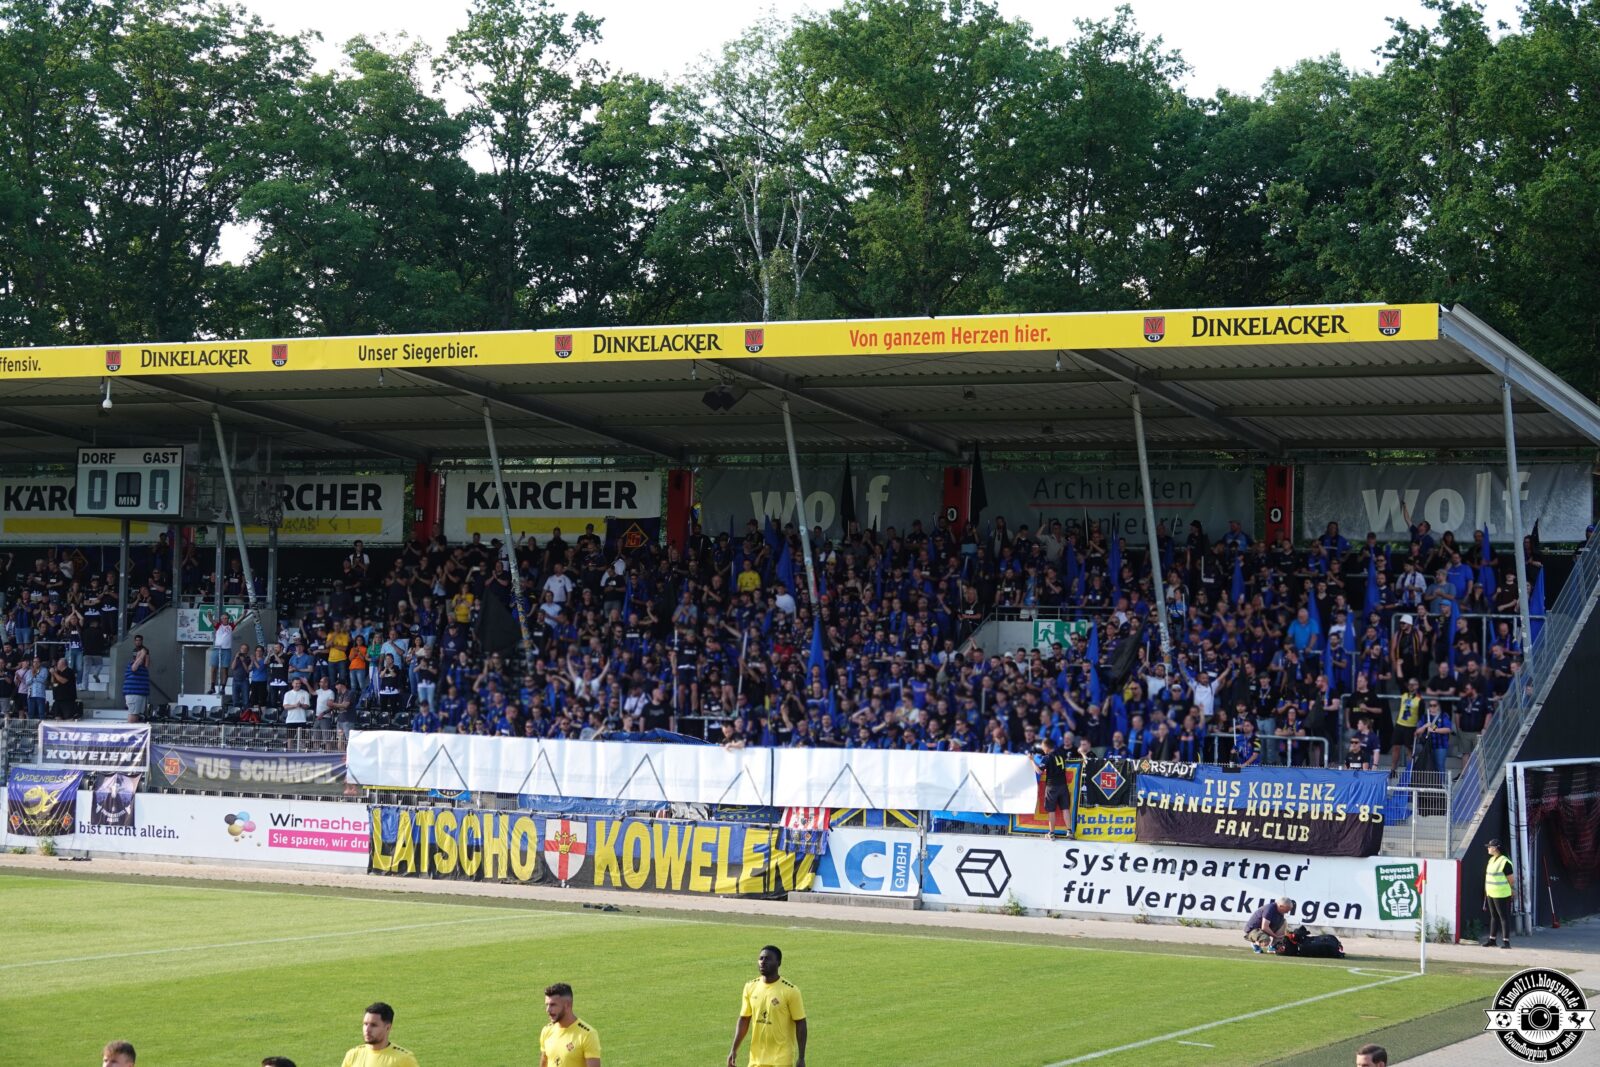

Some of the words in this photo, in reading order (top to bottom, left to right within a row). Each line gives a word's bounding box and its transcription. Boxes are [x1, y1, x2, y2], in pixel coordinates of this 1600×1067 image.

[1192, 314, 1349, 337] DINKELACKER
[593, 334, 723, 353] DINKELACKER
[850, 330, 877, 347] Von
[883, 330, 945, 350] ganzem
[952, 326, 1008, 345] Herzen
[1015, 324, 1051, 342] hier.
[141, 349, 251, 368] DINKELACKER
[359, 345, 398, 361] Unser
[403, 342, 478, 363] Siegerbier.
[82, 452, 116, 464] DORF
[143, 452, 178, 464] GAST
[466, 480, 638, 509] KÄRCHER
[1033, 476, 1192, 500] Architekten
[118, 496, 137, 505] MIN
[751, 474, 890, 532] wof
[47, 731, 91, 742] BLUE
[46, 749, 143, 762] KOWELENZ
[194, 757, 231, 780] TUS
[239, 757, 337, 784] SCHÄNGEL
[1204, 779, 1241, 797] TUS
[1249, 781, 1335, 801] KOBLENZ
[1136, 790, 1238, 815] SCHÄNGEL
[1246, 799, 1347, 822] HOTSPURS
[79, 821, 101, 834] bist
[105, 825, 137, 837] nicht
[140, 825, 179, 839] allein.
[273, 833, 288, 844] Sie
[291, 836, 329, 847] sparen,
[331, 837, 347, 848] wir
[1214, 819, 1310, 842] FAN-CLUB
[371, 807, 537, 882] LATSCHO
[894, 845, 907, 889] GMBH
[1063, 847, 1309, 882] Systempartner
[1380, 866, 1414, 874] bewusst
[1380, 872, 1414, 881] regional
[1063, 880, 1111, 904] für
